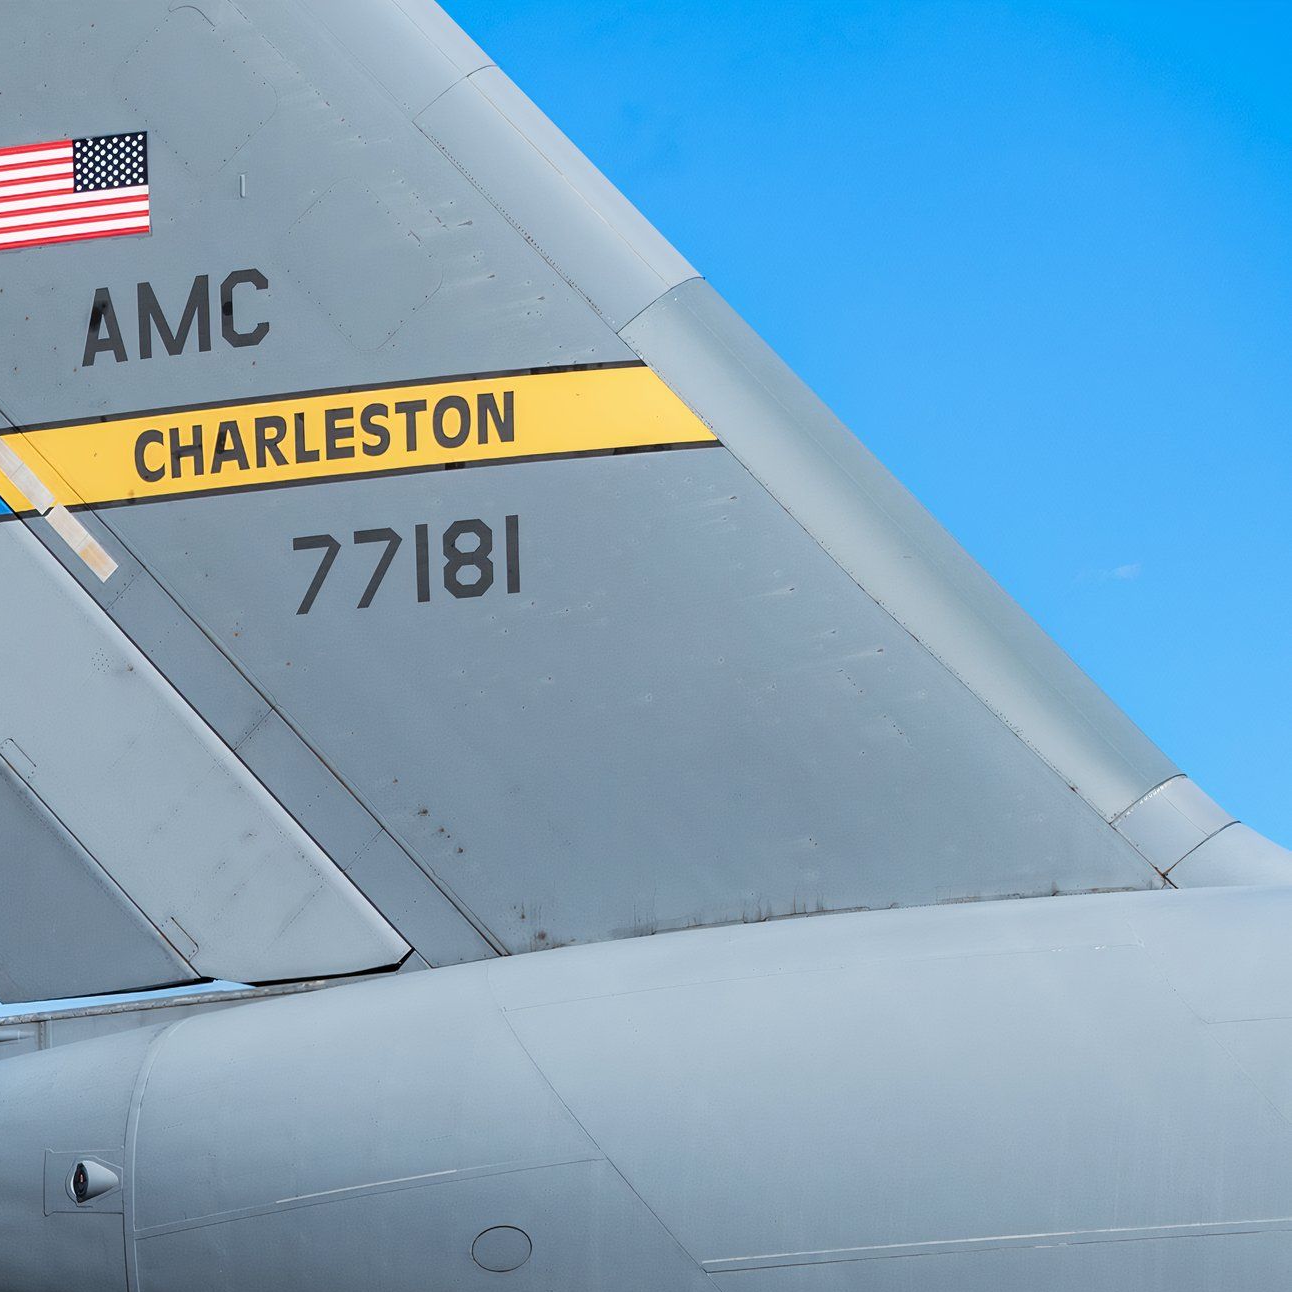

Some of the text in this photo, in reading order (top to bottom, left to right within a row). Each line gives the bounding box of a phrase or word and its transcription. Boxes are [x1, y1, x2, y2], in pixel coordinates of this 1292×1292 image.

[81, 268, 270, 368] AMC
[134, 390, 515, 483] CHARLESTON
[292, 514, 521, 616] 77181
